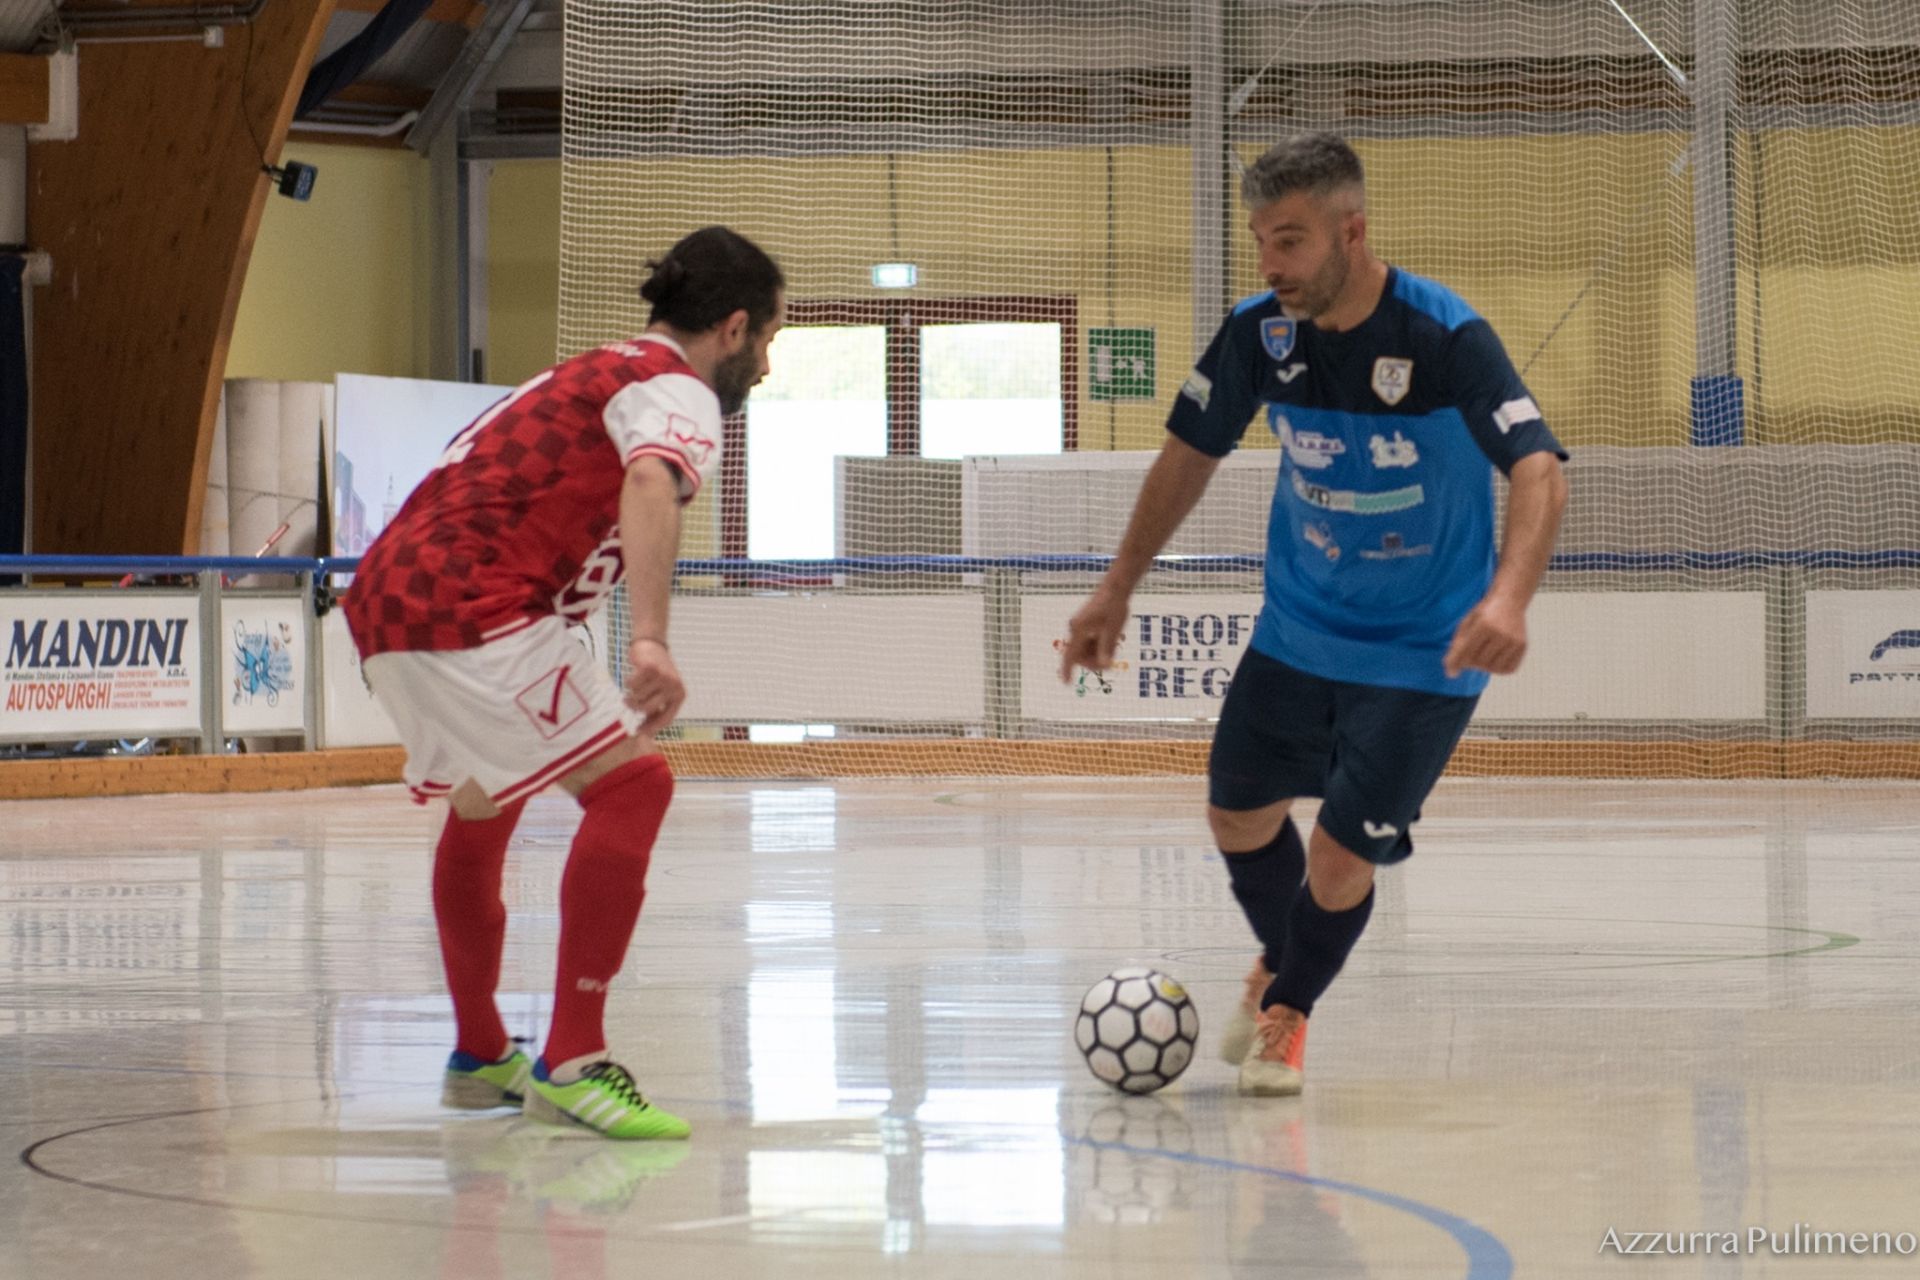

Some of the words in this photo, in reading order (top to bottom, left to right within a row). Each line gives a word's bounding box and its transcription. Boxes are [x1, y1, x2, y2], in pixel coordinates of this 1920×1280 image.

[5, 618, 188, 669] MANDINI
[1132, 614, 1258, 646] TROF
[1140, 649, 1222, 662] DELLE
[1849, 672, 1920, 684] PATT
[6, 682, 112, 711] AUTOSPURGHI
